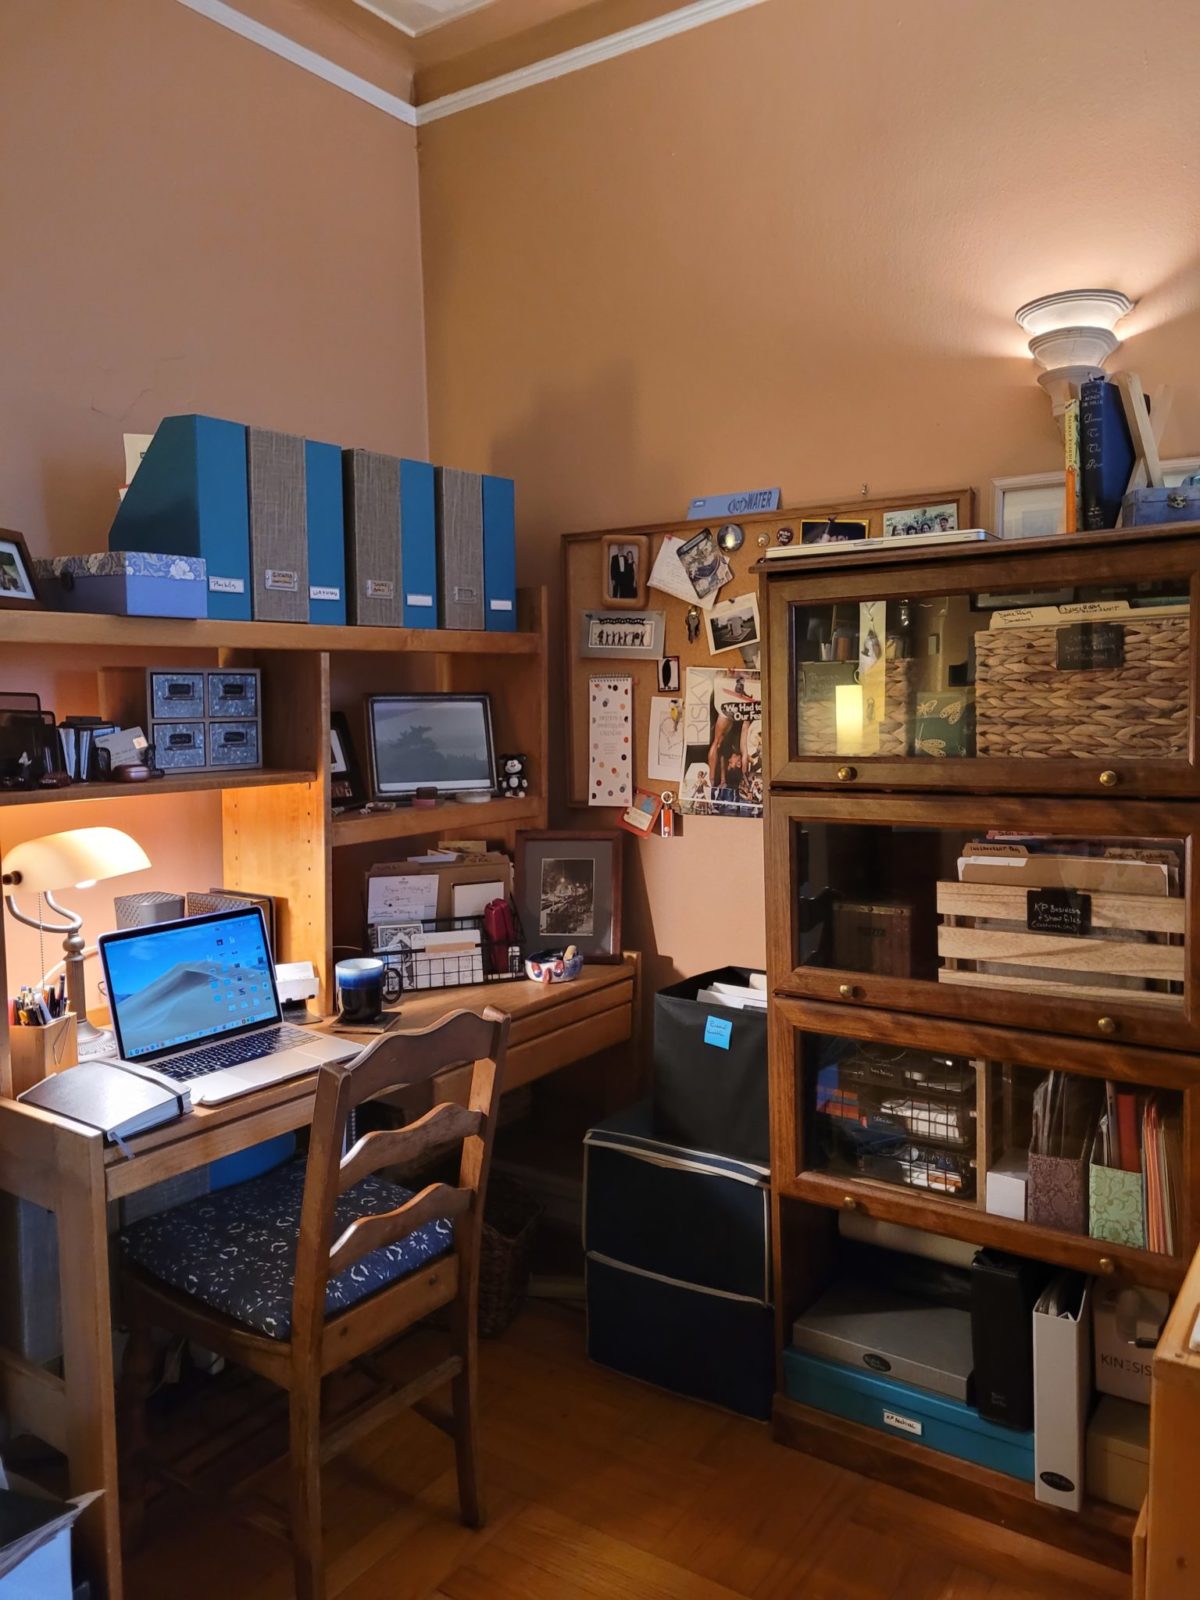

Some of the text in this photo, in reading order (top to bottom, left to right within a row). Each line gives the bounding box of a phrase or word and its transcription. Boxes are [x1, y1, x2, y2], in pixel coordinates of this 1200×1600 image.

[747, 491, 772, 510] WATER
[687, 668, 710, 744] RISKY
[724, 704, 738, 713] We
[739, 703, 754, 712] Had
[734, 712, 749, 721] Our
[1050, 905, 1081, 914] Business
[1101, 1353, 1152, 1377] KINESIS
